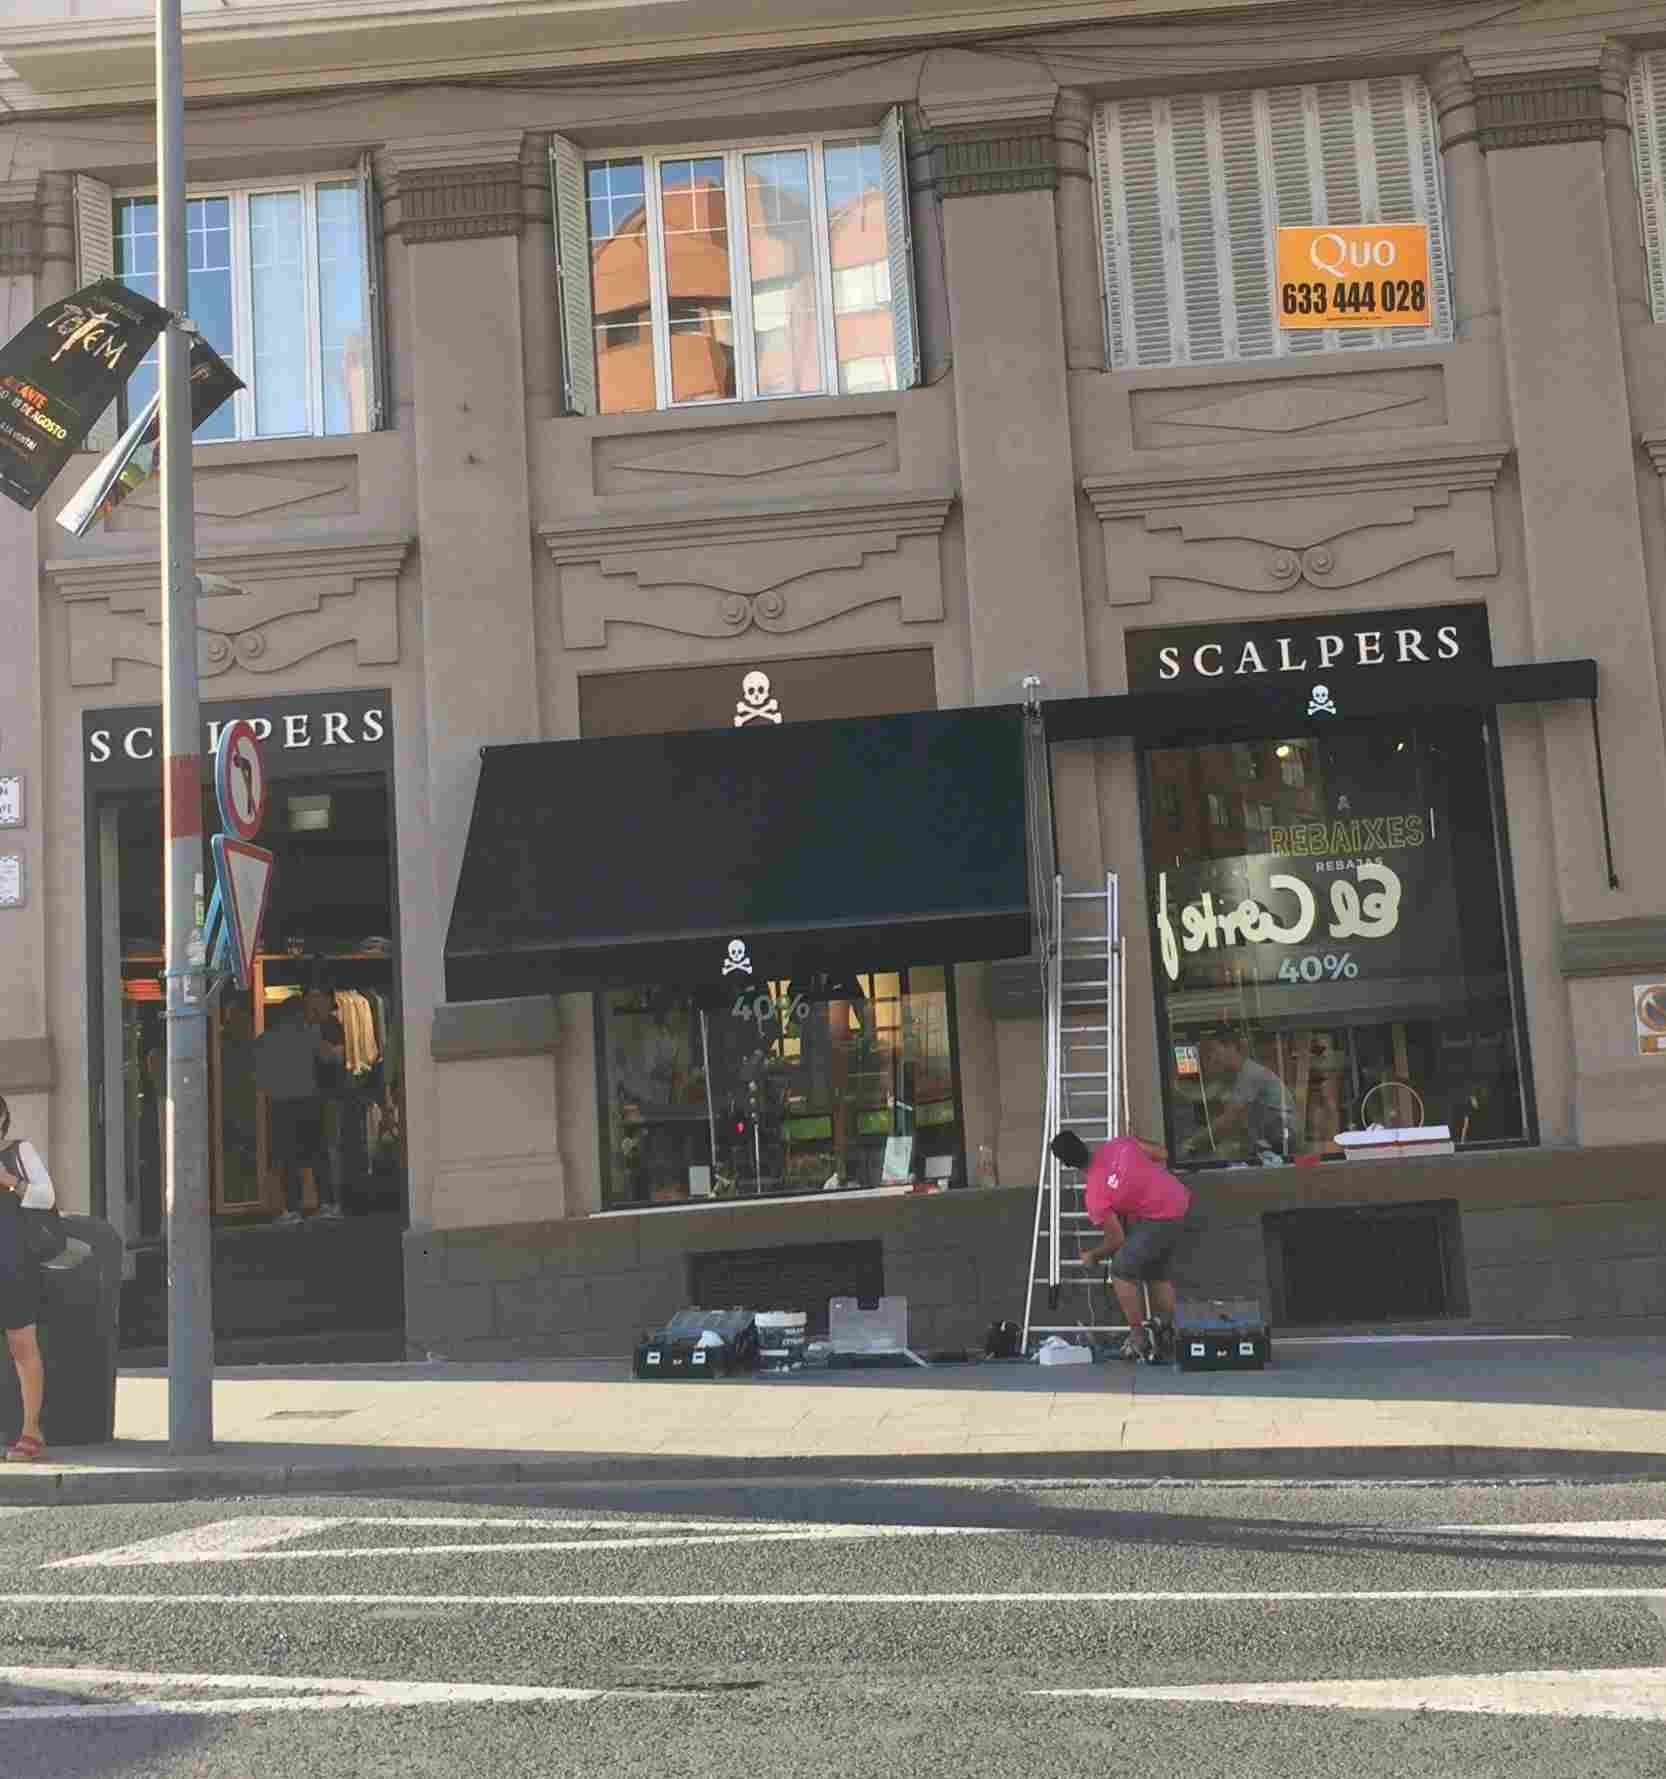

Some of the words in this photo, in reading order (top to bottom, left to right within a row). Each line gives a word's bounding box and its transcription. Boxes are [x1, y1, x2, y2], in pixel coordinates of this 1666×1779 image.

[1282, 282, 1328, 314] 633
[1333, 281, 1376, 313] 444
[1381, 279, 1425, 312] 028
[31, 410, 67, 439] AGOSTO
[1158, 625, 1460, 680] SCALPERS
[88, 709, 385, 763] SCLPERS
[1269, 815, 1425, 858] REBAIXES
[1277, 951, 1360, 984] 40%
